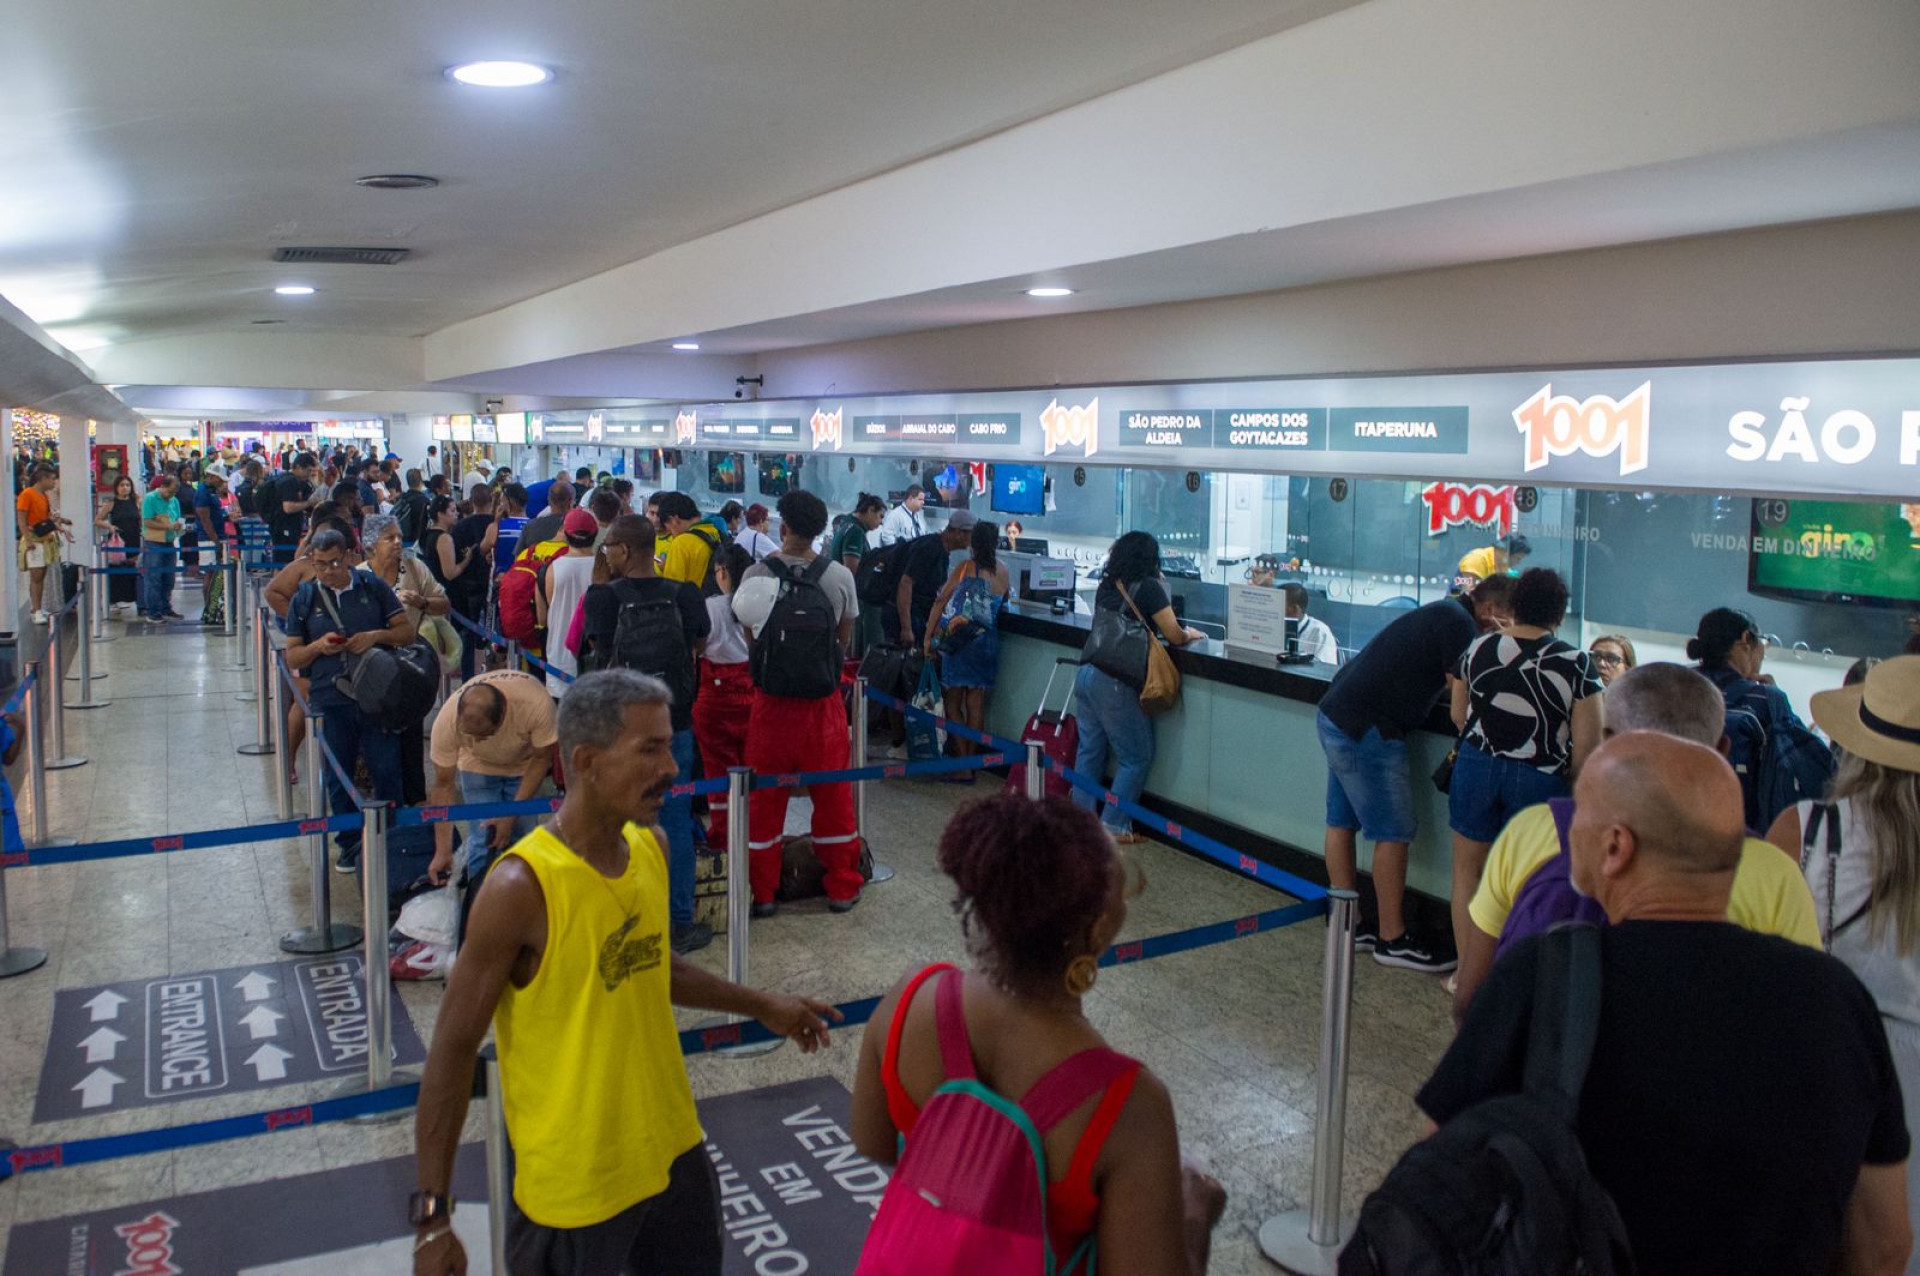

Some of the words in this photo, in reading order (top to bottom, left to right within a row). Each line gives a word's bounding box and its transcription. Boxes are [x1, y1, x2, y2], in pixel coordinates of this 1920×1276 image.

[810, 406, 843, 451] 1001
[938, 422, 957, 435] CABO
[969, 423, 989, 435] CABO
[989, 423, 1008, 435] FRIO
[1039, 397, 1099, 458] 1001
[1128, 413, 1149, 429] SÃO
[1151, 415, 1184, 429] PEDRO
[1186, 414, 1202, 429] DA
[1230, 412, 1280, 428] CAMPOS
[1281, 412, 1309, 428] DOS
[1354, 421, 1438, 439] ITAPERUNA
[1511, 380, 1651, 476] 1001
[1726, 396, 1877, 464] SÃO
[1145, 431, 1183, 446] ALDEIA
[1229, 430, 1309, 447] GOYTACAZES
[1331, 481, 1347, 499] 17
[1421, 481, 1518, 541] 1001
[1761, 500, 1787, 522] 19
[1690, 531, 1748, 551] VENDA
[1752, 535, 1778, 554] EM
[1783, 539, 1877, 561] DINHEIRO
[308, 962, 369, 1062] ENTRADA
[160, 981, 211, 1091] ENTRANCE
[759, 1161, 824, 1206] EM
[700, 1128, 809, 1276] HEIRO
